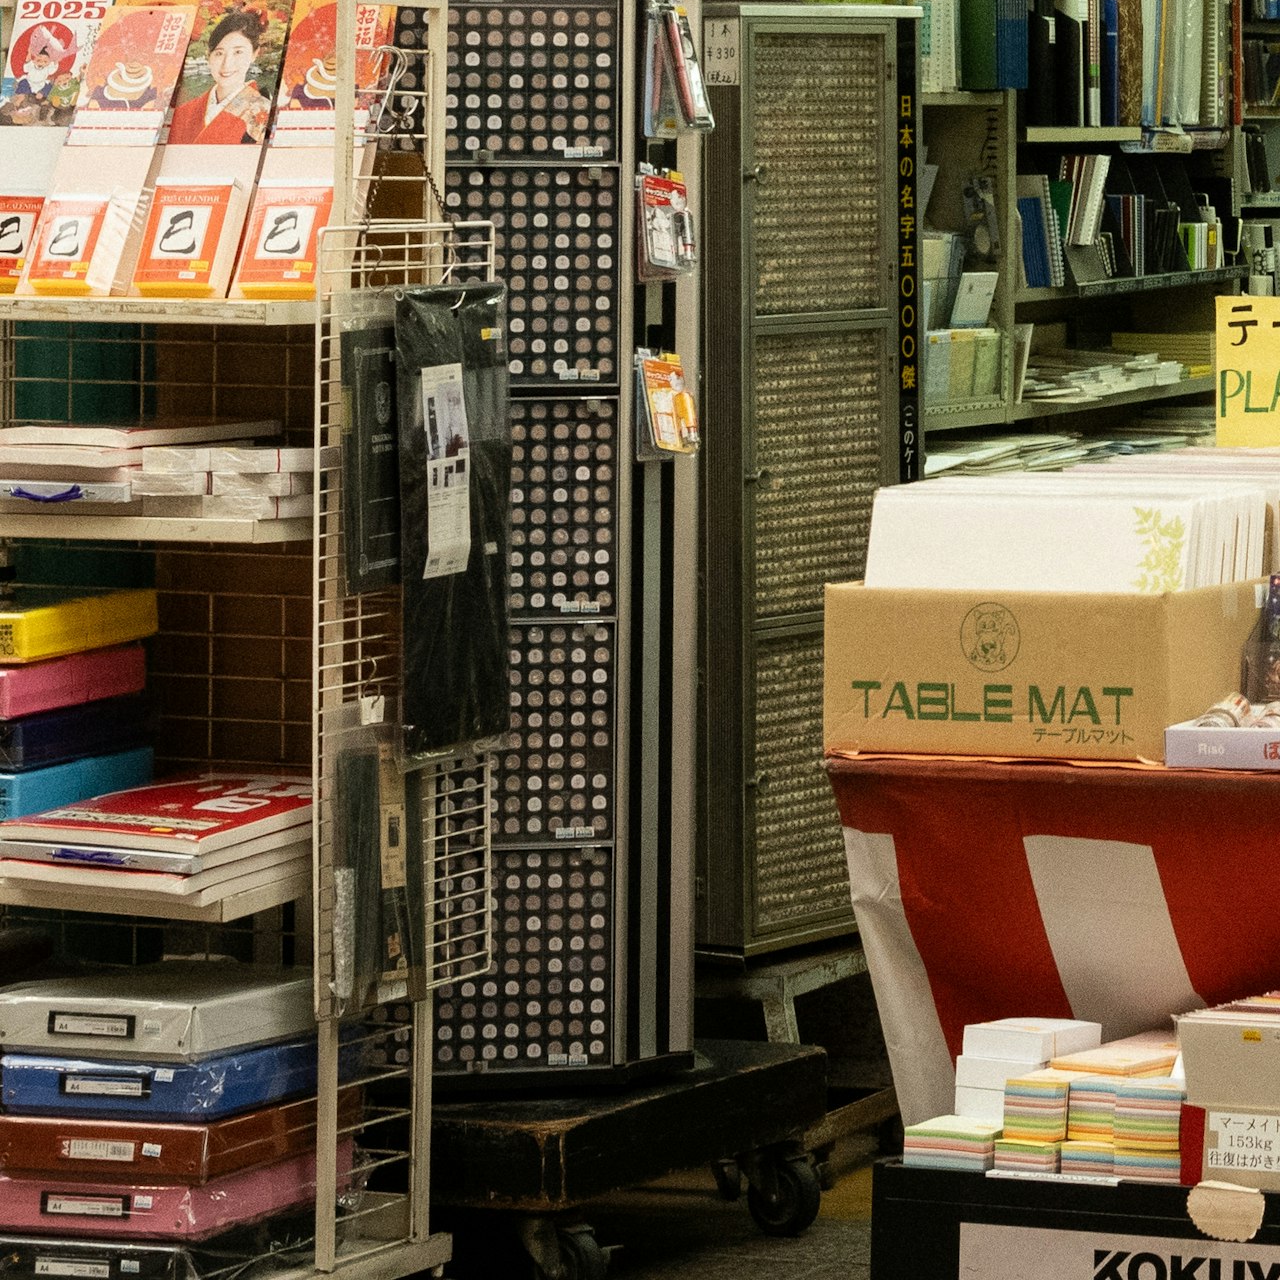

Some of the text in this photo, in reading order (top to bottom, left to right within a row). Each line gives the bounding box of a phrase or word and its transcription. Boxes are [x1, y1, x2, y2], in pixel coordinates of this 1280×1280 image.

[21, 1, 106, 19] 2025
[156, 13, 183, 53] 招福
[706, 48, 735, 61] ¥330
[178, 195, 220, 203] CALENDAR
[851, 680, 1134, 726] TABLE MAT
[1032, 727, 1134, 745] テーブルマット
[62, 1141, 69, 1155] A4
[1228, 1135, 1274, 1152] 153kg
